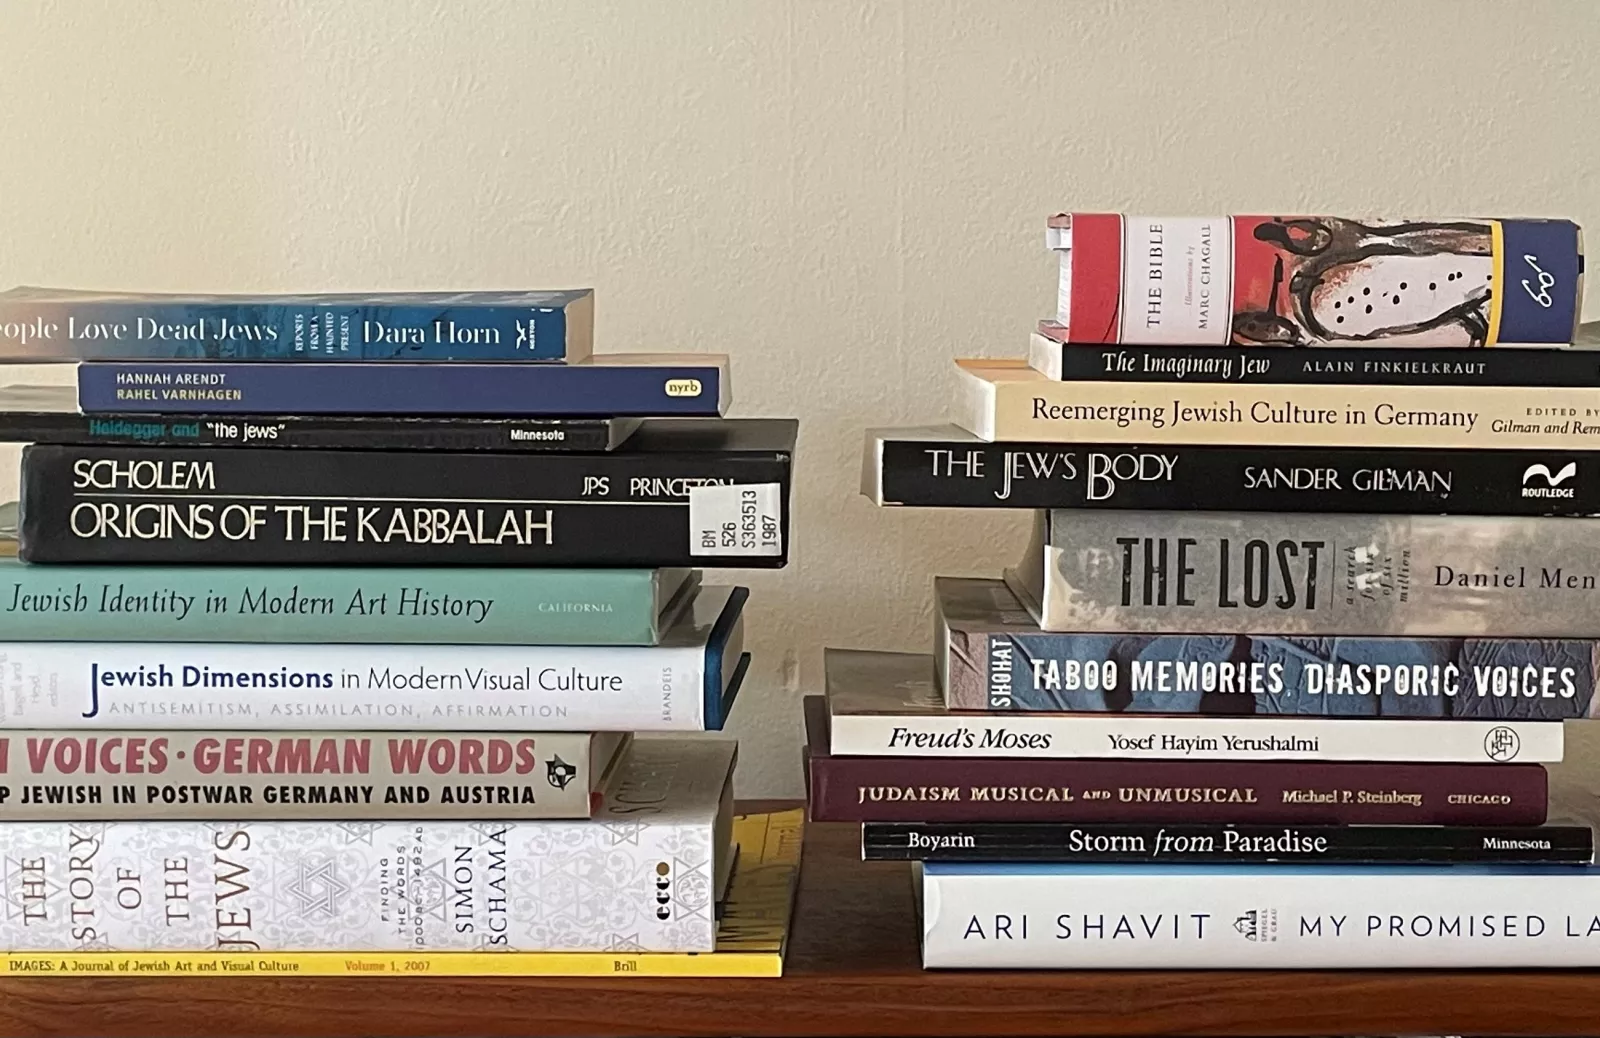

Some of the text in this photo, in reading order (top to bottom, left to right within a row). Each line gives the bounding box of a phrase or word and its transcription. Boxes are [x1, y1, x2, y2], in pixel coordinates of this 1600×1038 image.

[1189, 246, 1195, 255] by
[1147, 223, 1162, 328] THE BIBLE
[1198, 224, 1211, 329] MARC CHAGALL
[0, 316, 278, 346] ople Love Dead Jews
[294, 313, 304, 351] REPORTS
[310, 324, 319, 350] FROM
[325, 312, 334, 354] HAUNTED
[340, 315, 349, 352] PRESENT
[364, 320, 500, 345] Dara Horn
[117, 373, 226, 385] HANNAH ARENDT
[1102, 351, 1271, 379] The Imaginary Jew
[1302, 361, 1486, 375] ALAIN FINKIELKRAUT
[117, 389, 242, 400] RAHEL VARNHAGEN
[669, 381, 698, 394] nyrb
[1032, 397, 1479, 432] Reemerging Jewish Culture in Germany
[1491, 420, 1540, 434] Gilman
[1544, 421, 1569, 434] and
[1526, 408, 1600, 417] EDITED BY
[89, 420, 165, 439] Heidegger
[172, 421, 199, 436] and
[511, 429, 565, 441] Minnesota
[73, 459, 215, 489] SCHOLEM
[582, 477, 609, 496] JPS
[925, 450, 1451, 500] THE JEW'S BODY SANDER GILMAN
[1522, 488, 1574, 498] ROUTLEDGE
[70, 502, 553, 545] ORIGINS OF THE KABBALAH
[741, 491, 756, 548] S363513
[762, 515, 777, 547] 1987
[701, 530, 716, 548] BM
[722, 522, 737, 547] 526
[1116, 538, 1325, 610] THE LOST
[1344, 545, 1356, 605] a search
[1379, 557, 1394, 596] of six
[1397, 550, 1411, 602] million
[1434, 565, 1596, 589] Daniel Men
[7, 584, 494, 623] Jewish Identity in Modern Art History
[1360, 578, 1376, 602] for
[538, 603, 613, 612] CALIFORNIA
[991, 639, 1012, 707] SHOHAT
[1031, 658, 1576, 698] TABOO MEMORIES, DIASPORIC VOICES
[82, 663, 173, 717] Jewish
[182, 666, 333, 689] Dimensions
[341, 670, 359, 688] in
[368, 668, 462, 690] Modern
[464, 668, 530, 691] Visual
[538, 669, 623, 691] Culture
[662, 667, 671, 721] BRANDEIS
[109, 702, 568, 719] ANTISEMITISM, ASSIMILATION, AFFIRMATION
[889, 728, 1320, 754] Freud's Moses Yosef Hayim Yerushalmi
[388, 738, 536, 775] WORDS
[21, 785, 535, 804] JEWISH IN POSTWAR GERMANY AND AUSTRIA
[858, 787, 1423, 806] JUDAISM MUSICAL AND UNMUSICAL Michael P. Steinberg
[1448, 794, 1511, 804] CHICAGO
[908, 832, 975, 850] Boyarin
[1069, 829, 1328, 856] Storm from Paradise
[1483, 838, 1551, 850] Minnesota
[21, 857, 48, 926] THE
[69, 830, 99, 941] STORY
[117, 868, 142, 909] OF
[164, 858, 189, 926] THE
[215, 830, 260, 950] JEWS
[380, 858, 388, 921] FINDING
[397, 845, 406, 934] THE WORDS
[454, 845, 474, 933] SIMON
[488, 829, 508, 945] SCHAMA
[657, 862, 669, 920] ecco
[963, 914, 1211, 939] ARI SHAVIT
[1300, 915, 1600, 937] MY PROMISED LA
[9, 960, 299, 972] IMAGES: A Journal of Jewish Art and Visual Culture
[345, 961, 431, 973] Volume 1, 2007
[614, 961, 637, 971] Brill
